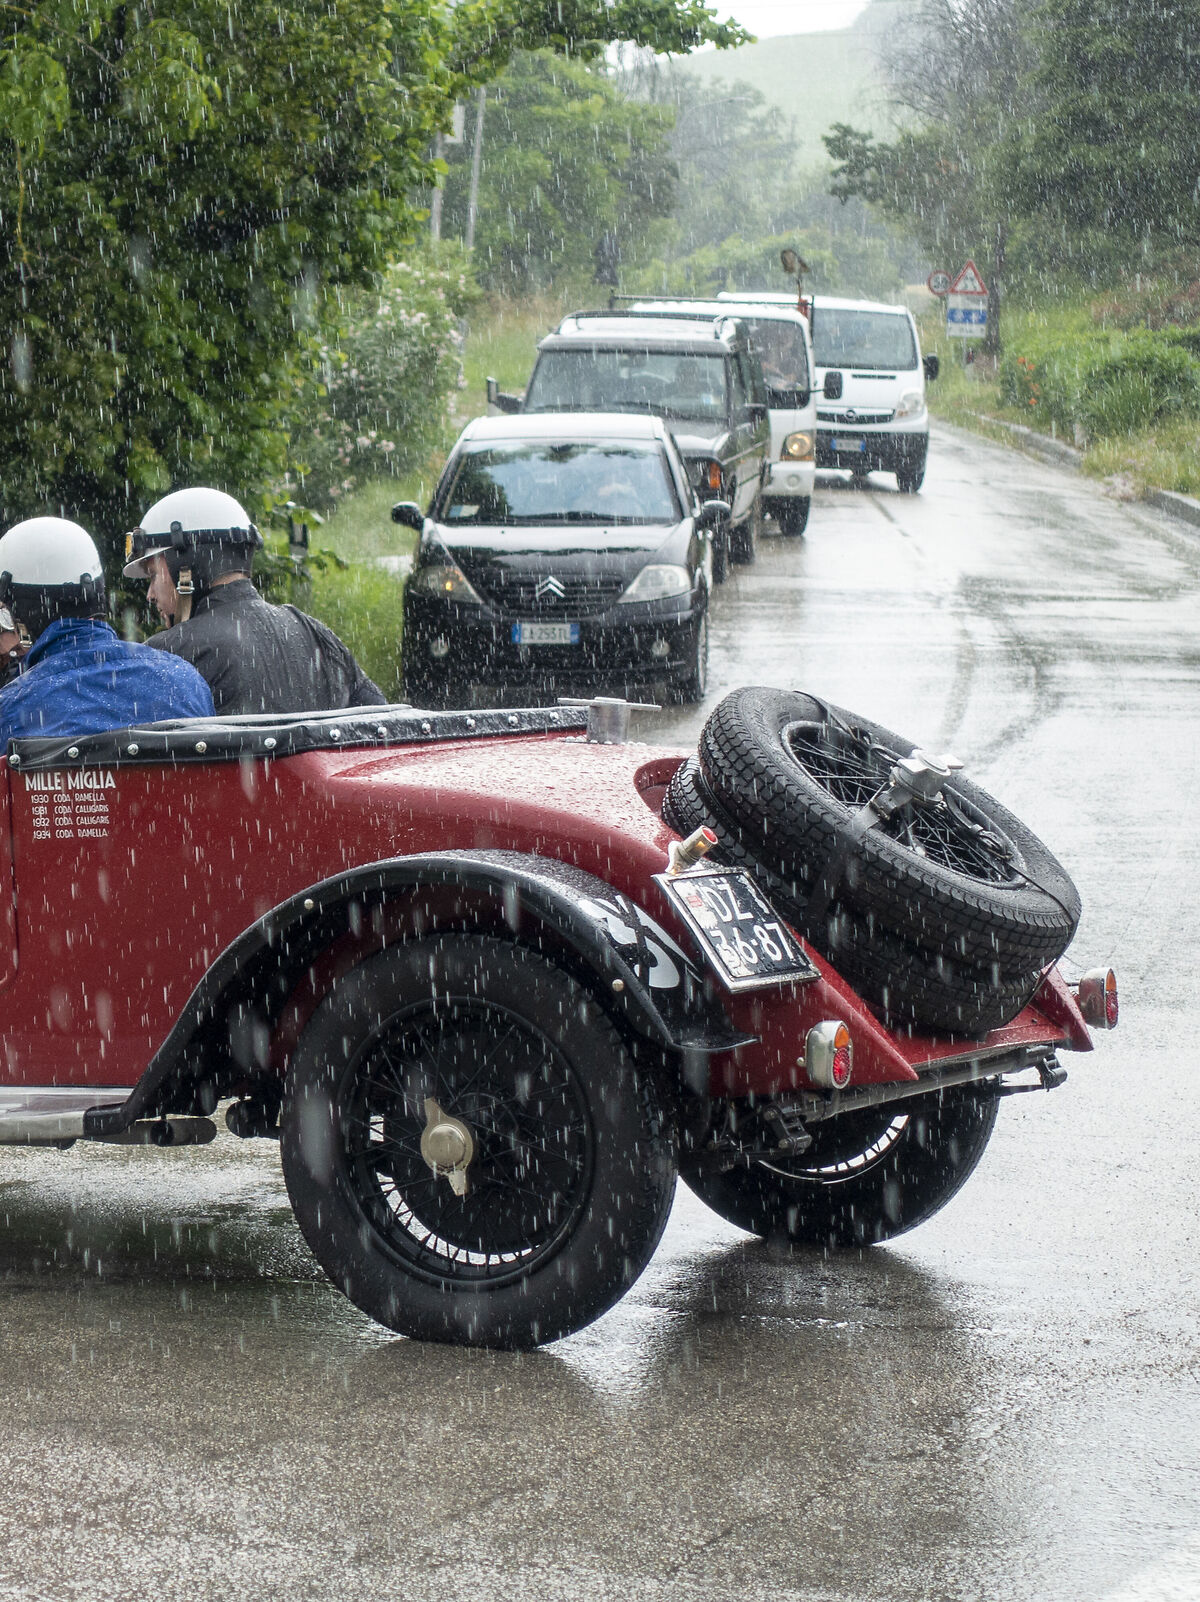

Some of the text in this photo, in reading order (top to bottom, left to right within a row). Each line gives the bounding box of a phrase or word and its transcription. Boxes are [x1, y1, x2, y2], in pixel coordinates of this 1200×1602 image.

[25, 770, 116, 791] MILLE MIGLIA
[31, 792, 106, 804] 1930 CODA RAMELLA
[32, 804, 109, 815] 1931 CODA CALLIGARIS
[32, 815, 110, 828] 1932 CODA CALLIGARIS
[33, 828, 108, 840] 1934 CODA RAMELLA
[698, 883, 753, 923] DZ
